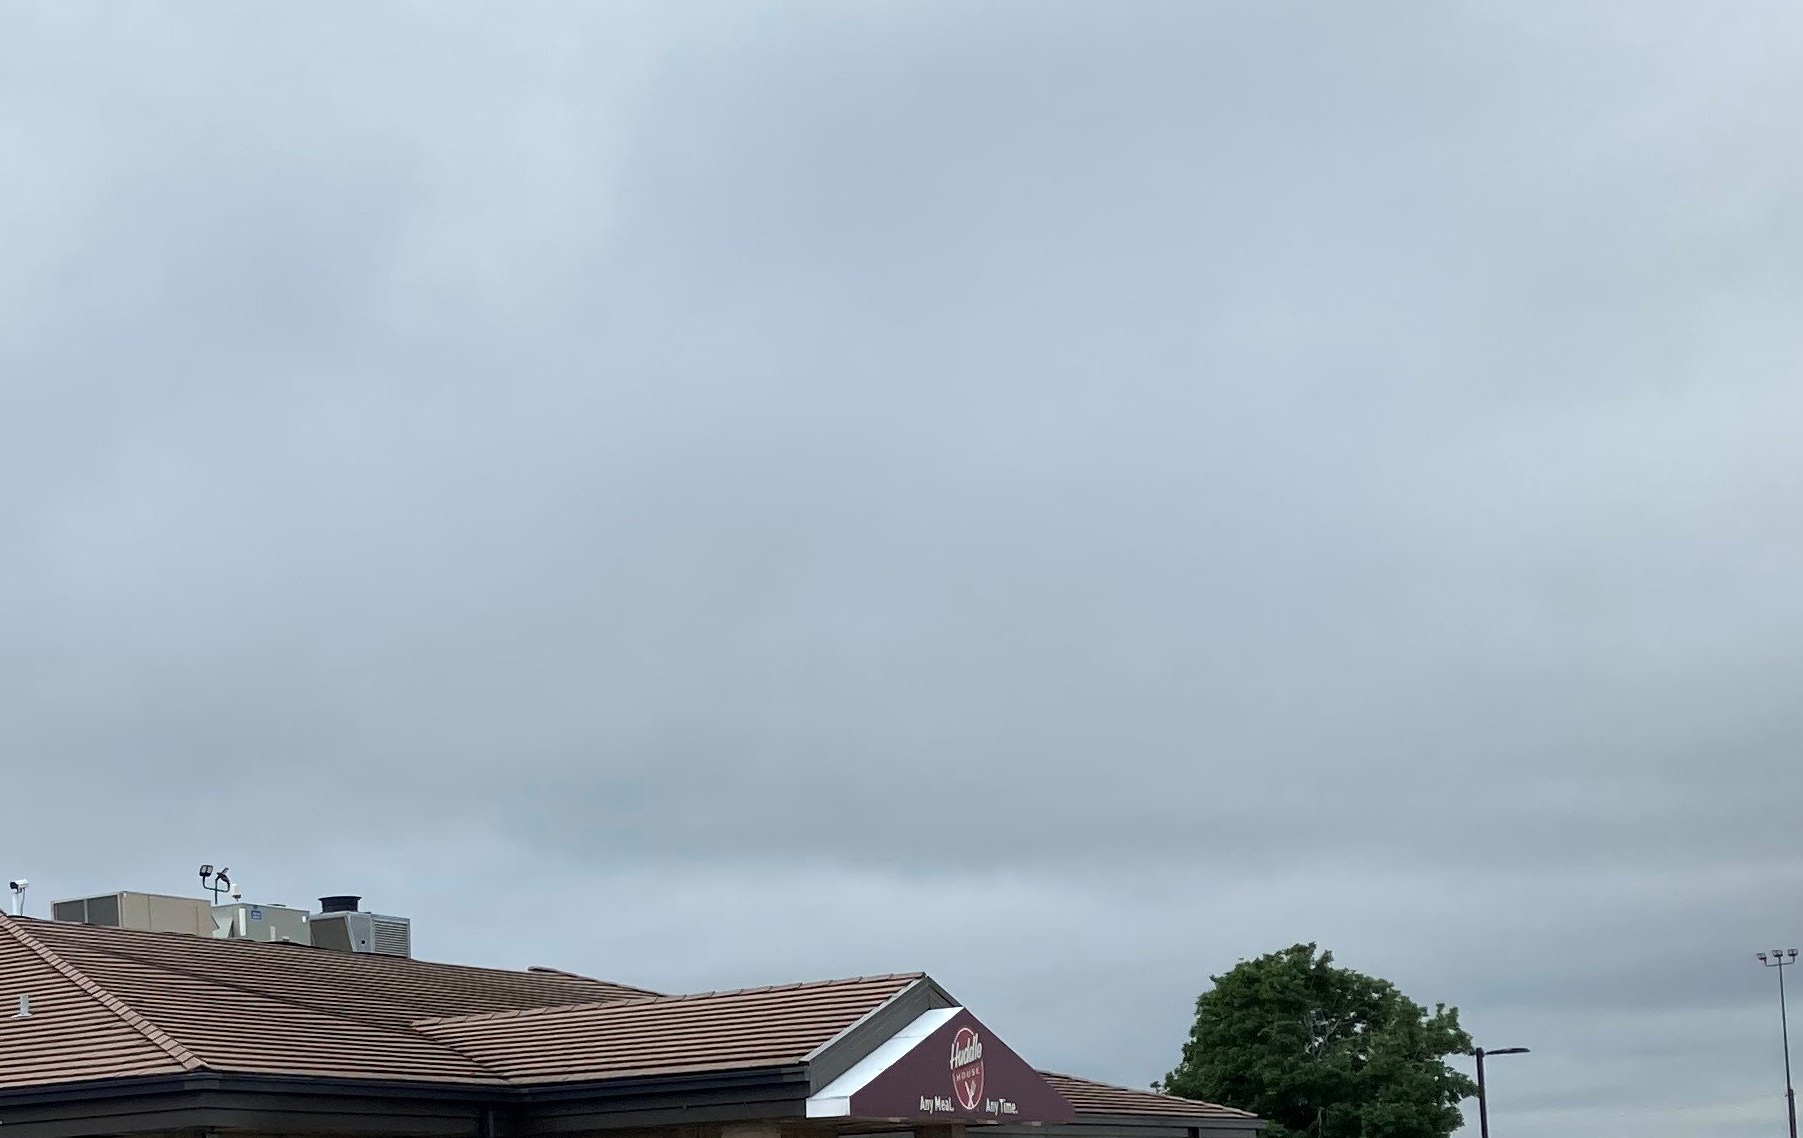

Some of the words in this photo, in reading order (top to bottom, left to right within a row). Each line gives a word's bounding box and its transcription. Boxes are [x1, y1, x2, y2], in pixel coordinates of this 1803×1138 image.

[950, 1032, 983, 1070] Huddle
[956, 1067, 981, 1081] HOUSE
[919, 1095, 934, 1114] Any
[985, 1098, 999, 1116] Any
